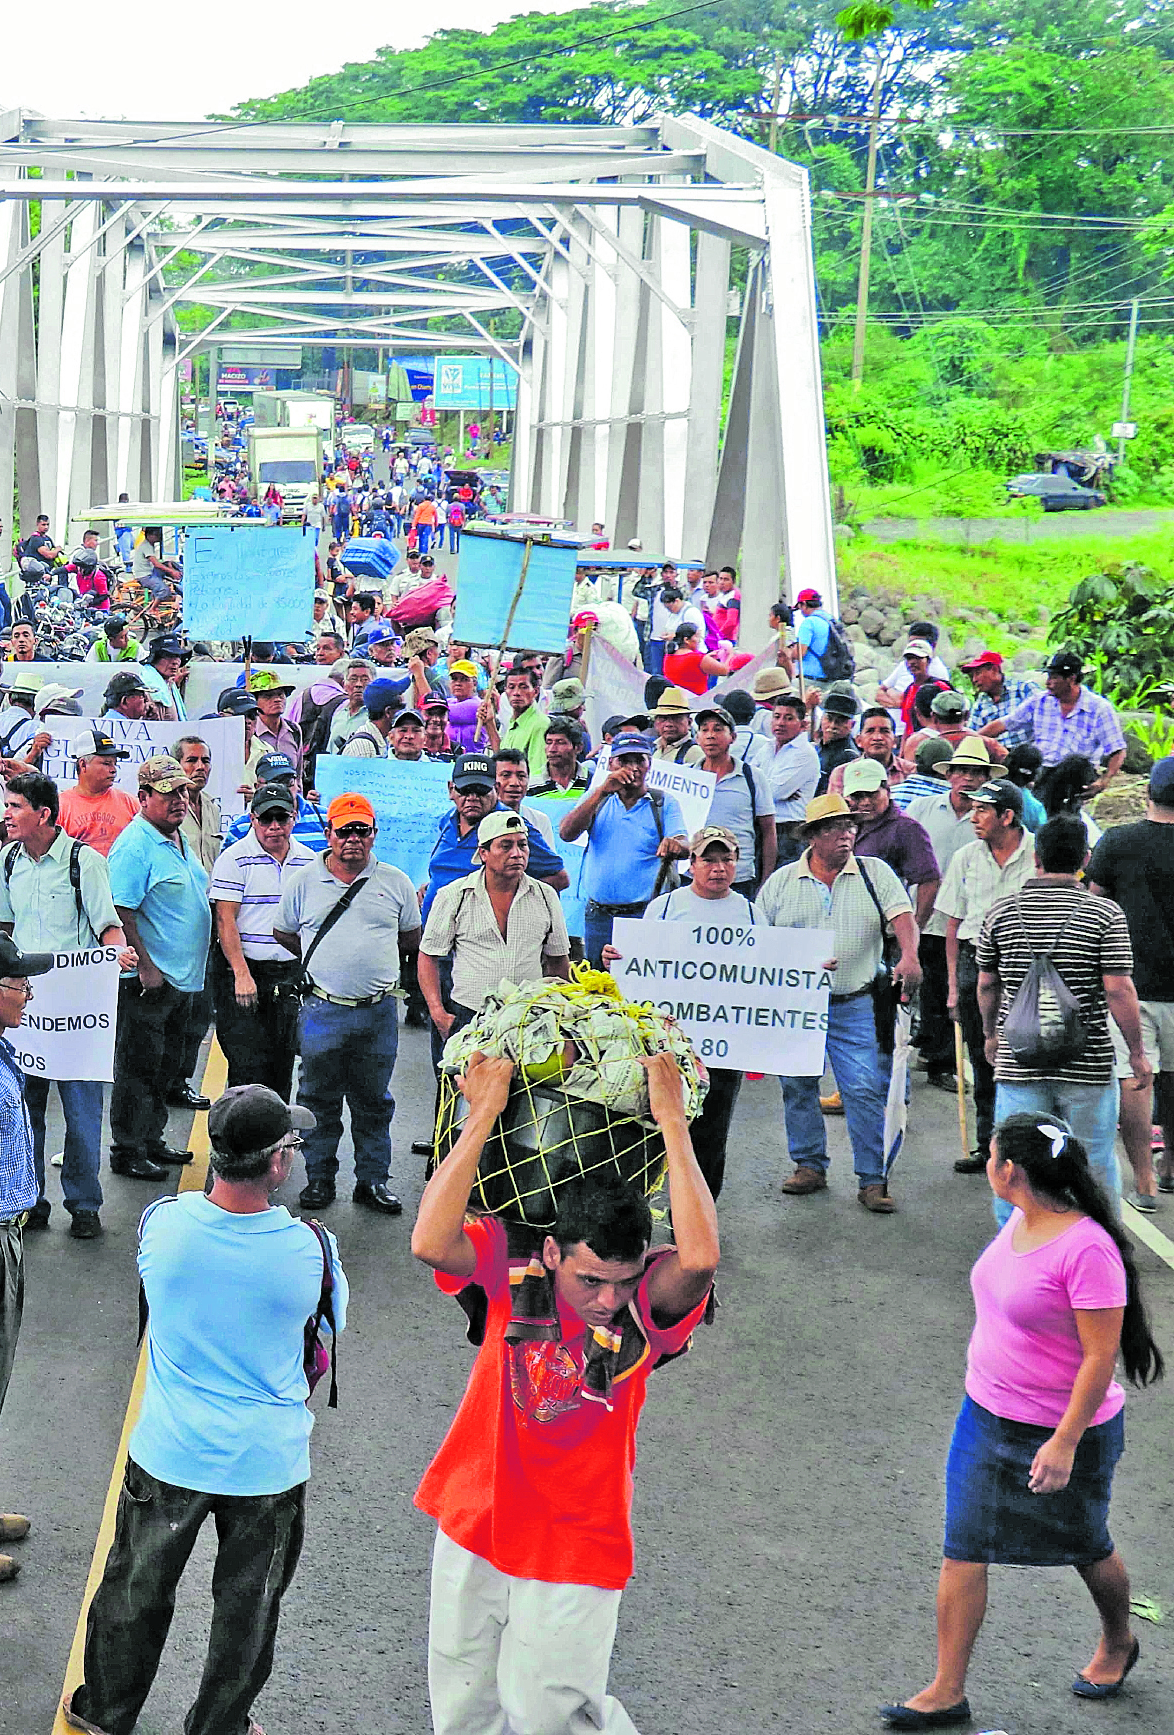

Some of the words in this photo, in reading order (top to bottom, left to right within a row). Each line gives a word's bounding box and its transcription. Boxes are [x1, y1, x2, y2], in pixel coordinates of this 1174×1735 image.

[90, 719, 152, 741] VIVA
[464, 762, 488, 772] KING
[692, 926, 756, 947] 100%
[57, 948, 117, 968] DIMOS
[625, 958, 833, 990] ANTICOMUNISTA
[21, 1013, 110, 1031] ENDEMOS
[700, 1039, 729, 1057] 80
[14, 1052, 46, 1070] HOS
